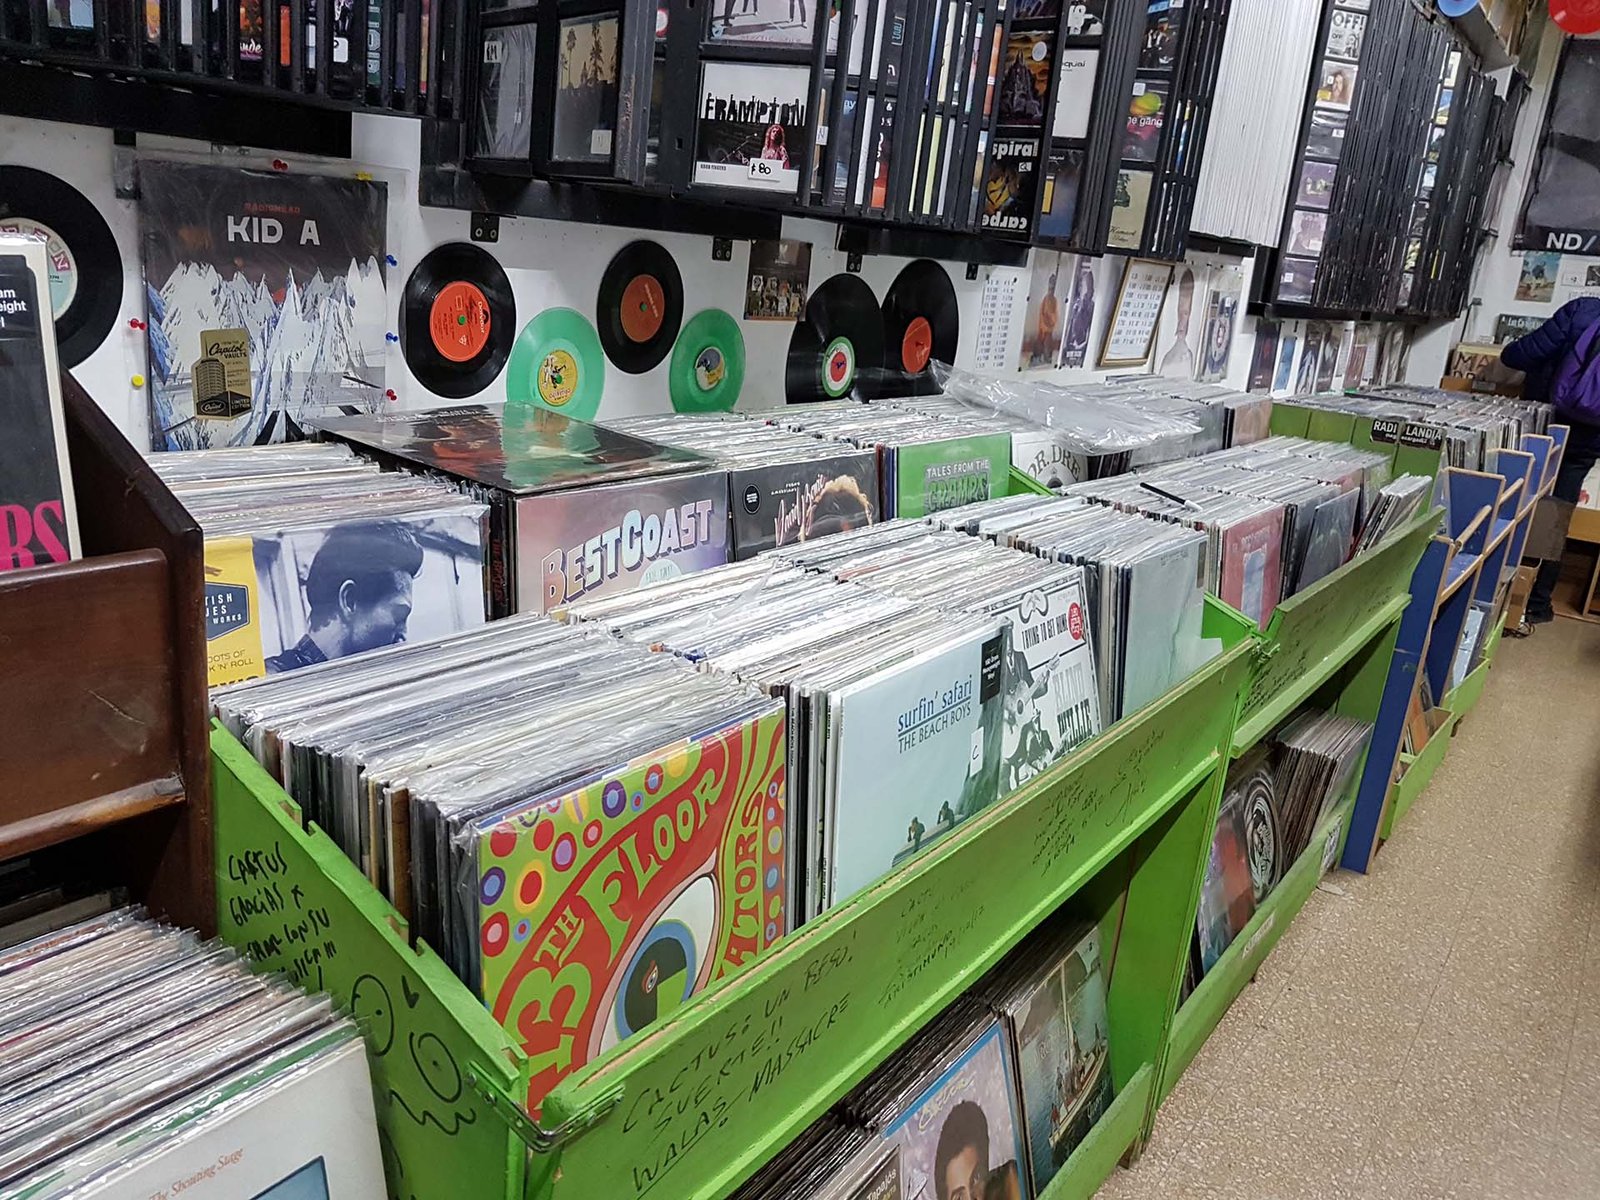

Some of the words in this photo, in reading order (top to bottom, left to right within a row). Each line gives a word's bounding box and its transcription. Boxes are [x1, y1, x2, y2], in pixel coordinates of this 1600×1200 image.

[706, 92, 806, 126] FRAMPTON
[1140, 117, 1163, 128] gang
[227, 215, 284, 244] KID
[300, 219, 320, 246] A
[0, 300, 27, 314] eight
[927, 466, 952, 479] TALES
[953, 462, 975, 475] FROM
[976, 459, 990, 470] THE
[1051, 444, 1081, 484] DRE
[230, 657, 255, 668] ROLL
[232, 650, 246, 660] OF
[941, 674, 972, 707] safari
[898, 731, 916, 754] THE
[919, 714, 948, 746] BEACH
[950, 702, 971, 725] BOYS
[765, 987, 791, 1017] UN
[217, 1148, 244, 1171] Stage
